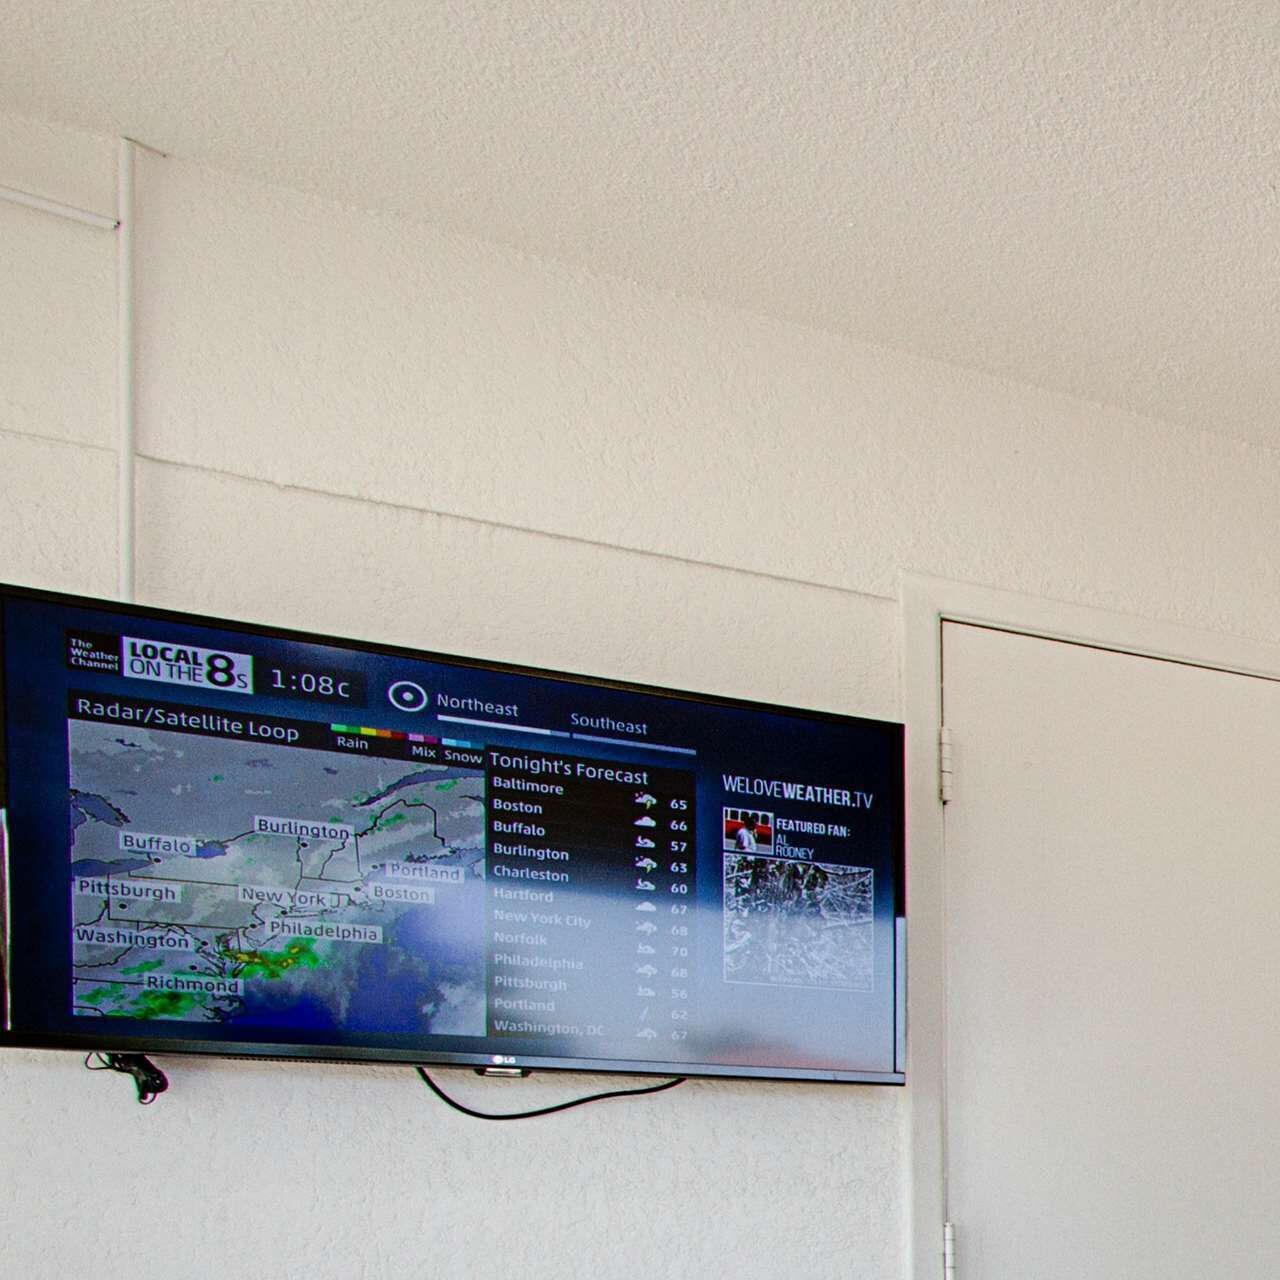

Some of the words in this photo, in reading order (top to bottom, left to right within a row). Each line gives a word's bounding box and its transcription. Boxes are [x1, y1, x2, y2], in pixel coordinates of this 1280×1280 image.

[70, 638, 92, 649] The
[70, 648, 119, 661] Weather
[130, 641, 202, 666] LOCAL
[71, 657, 119, 671] Channel
[130, 659, 160, 677] ON
[166, 663, 203, 683] THE
[437, 693, 519, 717] Northeast
[78, 699, 243, 734] Radar/Satellite
[249, 721, 299, 742] Loop
[571, 713, 648, 735] Southeast
[337, 736, 368, 749] Rain
[412, 746, 436, 758] Mix
[445, 750, 482, 764] Snow
[490, 752, 571, 775] Tonight's
[577, 763, 649, 785] Forecast
[493, 776, 564, 795] Baltimore
[722, 774, 873, 809] WELOVEWEATHER.TV
[493, 799, 543, 815] Boston
[671, 800, 687, 810] 65
[258, 819, 349, 840] Burlington
[493, 821, 545, 837] Buffalo
[671, 821, 687, 832] 66
[776, 818, 826, 835] FEATURED
[123, 835, 190, 853] Buffalo
[494, 843, 569, 861] Burlington
[671, 841, 687, 852] 57
[391, 863, 459, 880] Portland
[494, 865, 569, 882] Charleston
[671, 863, 687, 873] 63
[79, 880, 175, 900] Pittsburgh
[242, 888, 282, 901] New
[288, 891, 325, 905] York
[374, 886, 429, 901] Boston
[494, 887, 553, 903] Hartford
[671, 883, 688, 894] 60
[671, 905, 687, 915] 67
[494, 910, 527, 922] New
[531, 913, 562, 925] York
[566, 915, 591, 929] City
[76, 929, 189, 948] Washington
[271, 921, 377, 941] Philadelphia
[494, 932, 547, 945] Norfolk
[495, 954, 584, 970] Philadelphia
[147, 976, 238, 993] Richmond
[495, 976, 567, 993] Pittsburgh
[495, 999, 555, 1012] Portland
